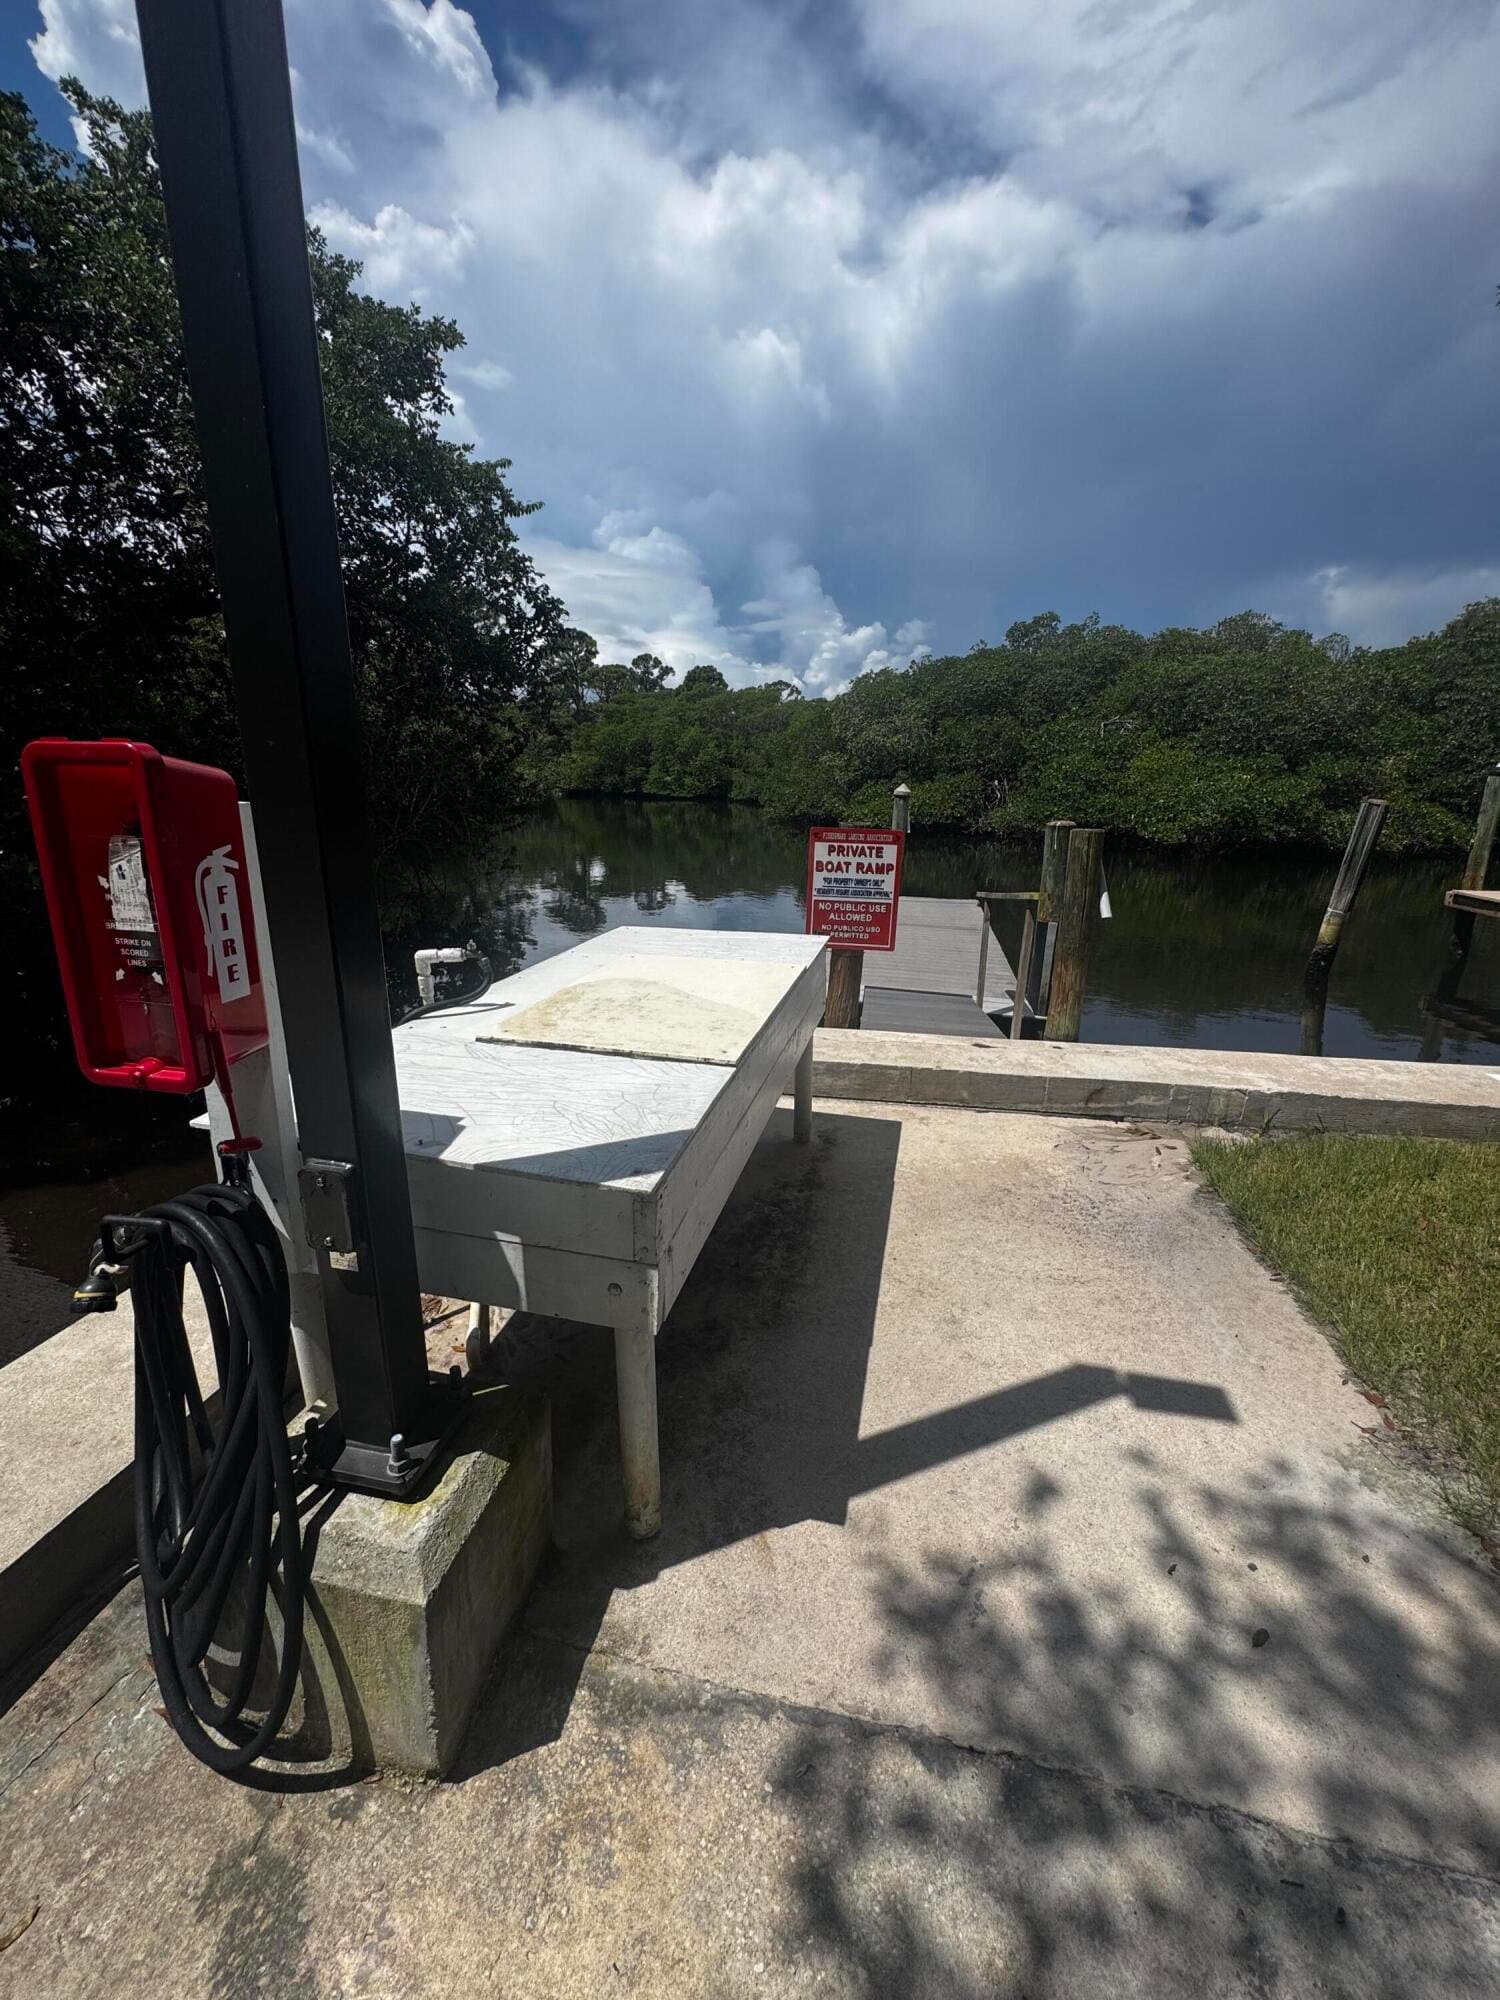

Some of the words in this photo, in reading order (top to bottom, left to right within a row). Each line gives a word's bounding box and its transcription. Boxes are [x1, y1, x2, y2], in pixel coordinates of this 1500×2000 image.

[827, 844, 884, 859] PRIVATE
[815, 860, 852, 873] BOAT
[855, 862, 895, 875] RAMP
[833, 877, 853, 886] PROPERTY
[834, 903, 866, 911] PUBLIC
[869, 904, 887, 912] USE
[829, 913, 873, 922] ALLOWED
[217, 885, 241, 983] FIRE
[830, 931, 870, 940] PERMITTED
[114, 937, 139, 946] STRIKE
[140, 939, 152, 947] ON
[120, 948, 149, 957] SCORED
[127, 959, 147, 967] LINES
